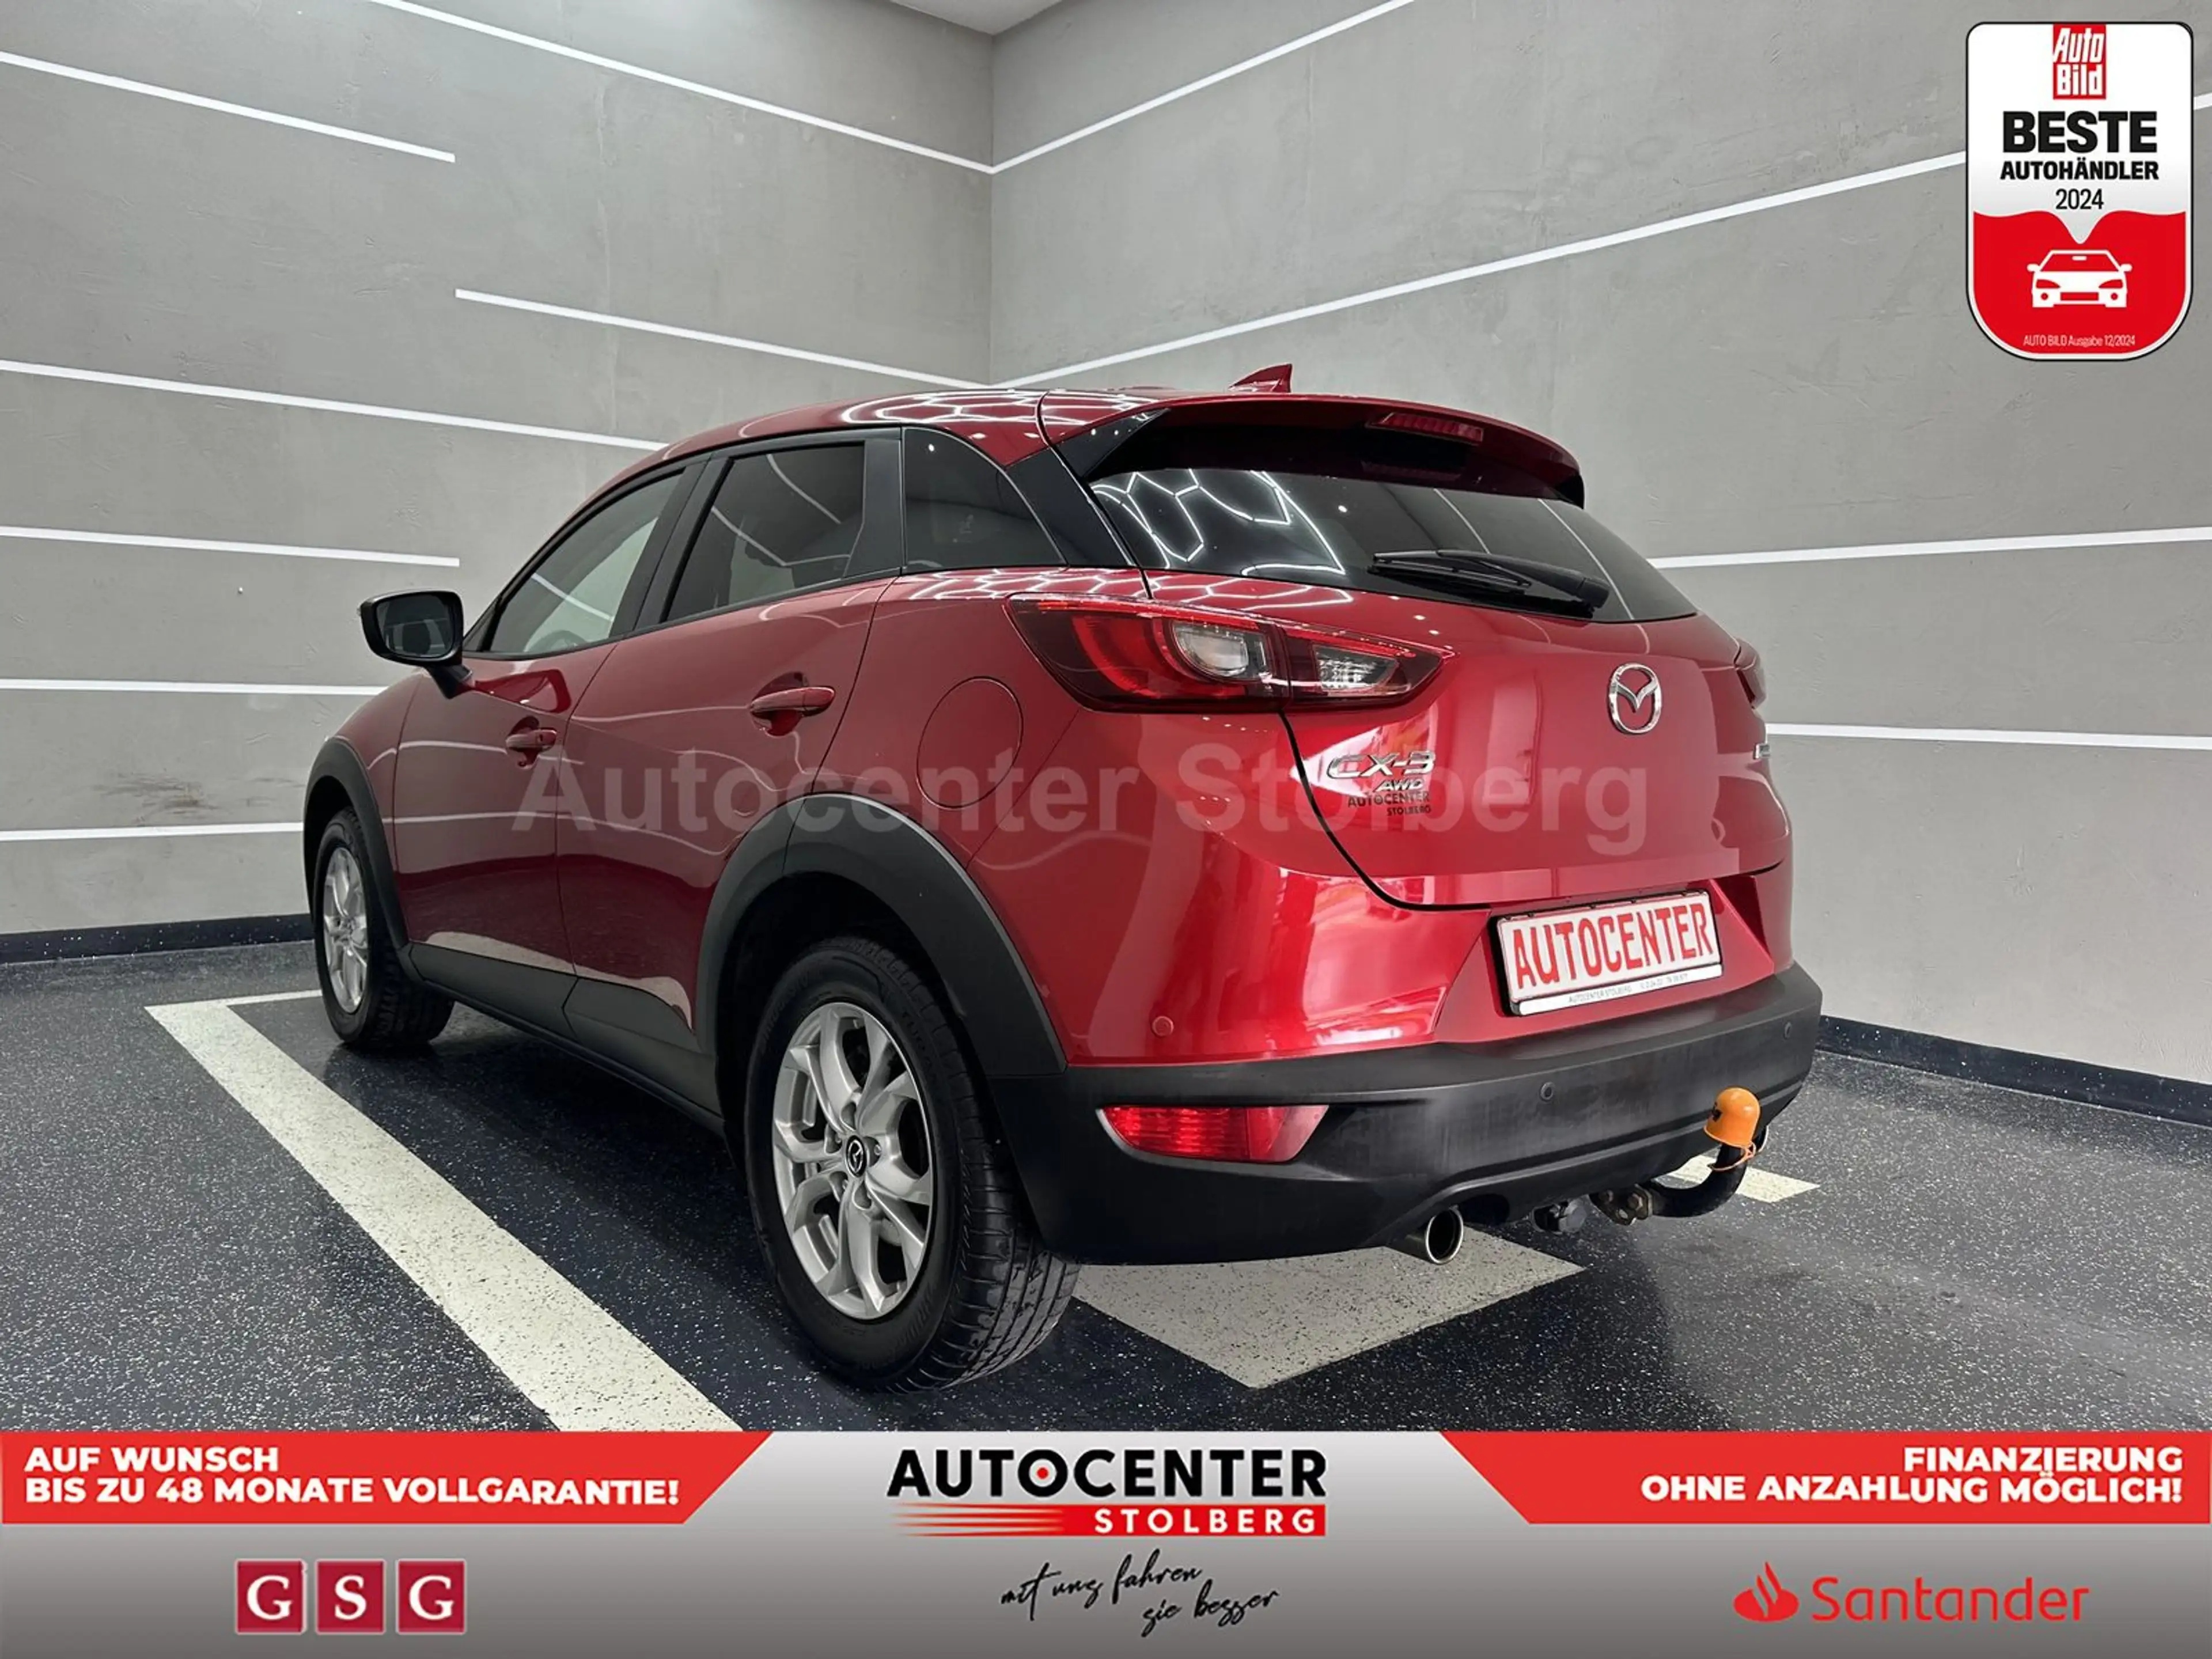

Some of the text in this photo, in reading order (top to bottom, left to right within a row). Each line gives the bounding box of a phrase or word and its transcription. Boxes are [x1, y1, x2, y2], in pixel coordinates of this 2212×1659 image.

[1327, 750, 1436, 779] CX-3
[1373, 778, 1425, 793] AWD
[1348, 791, 1431, 808] AUTOCENTER
[1387, 805, 1431, 816] STOLBERG
[1513, 903, 1713, 990] AUTOCENTER
